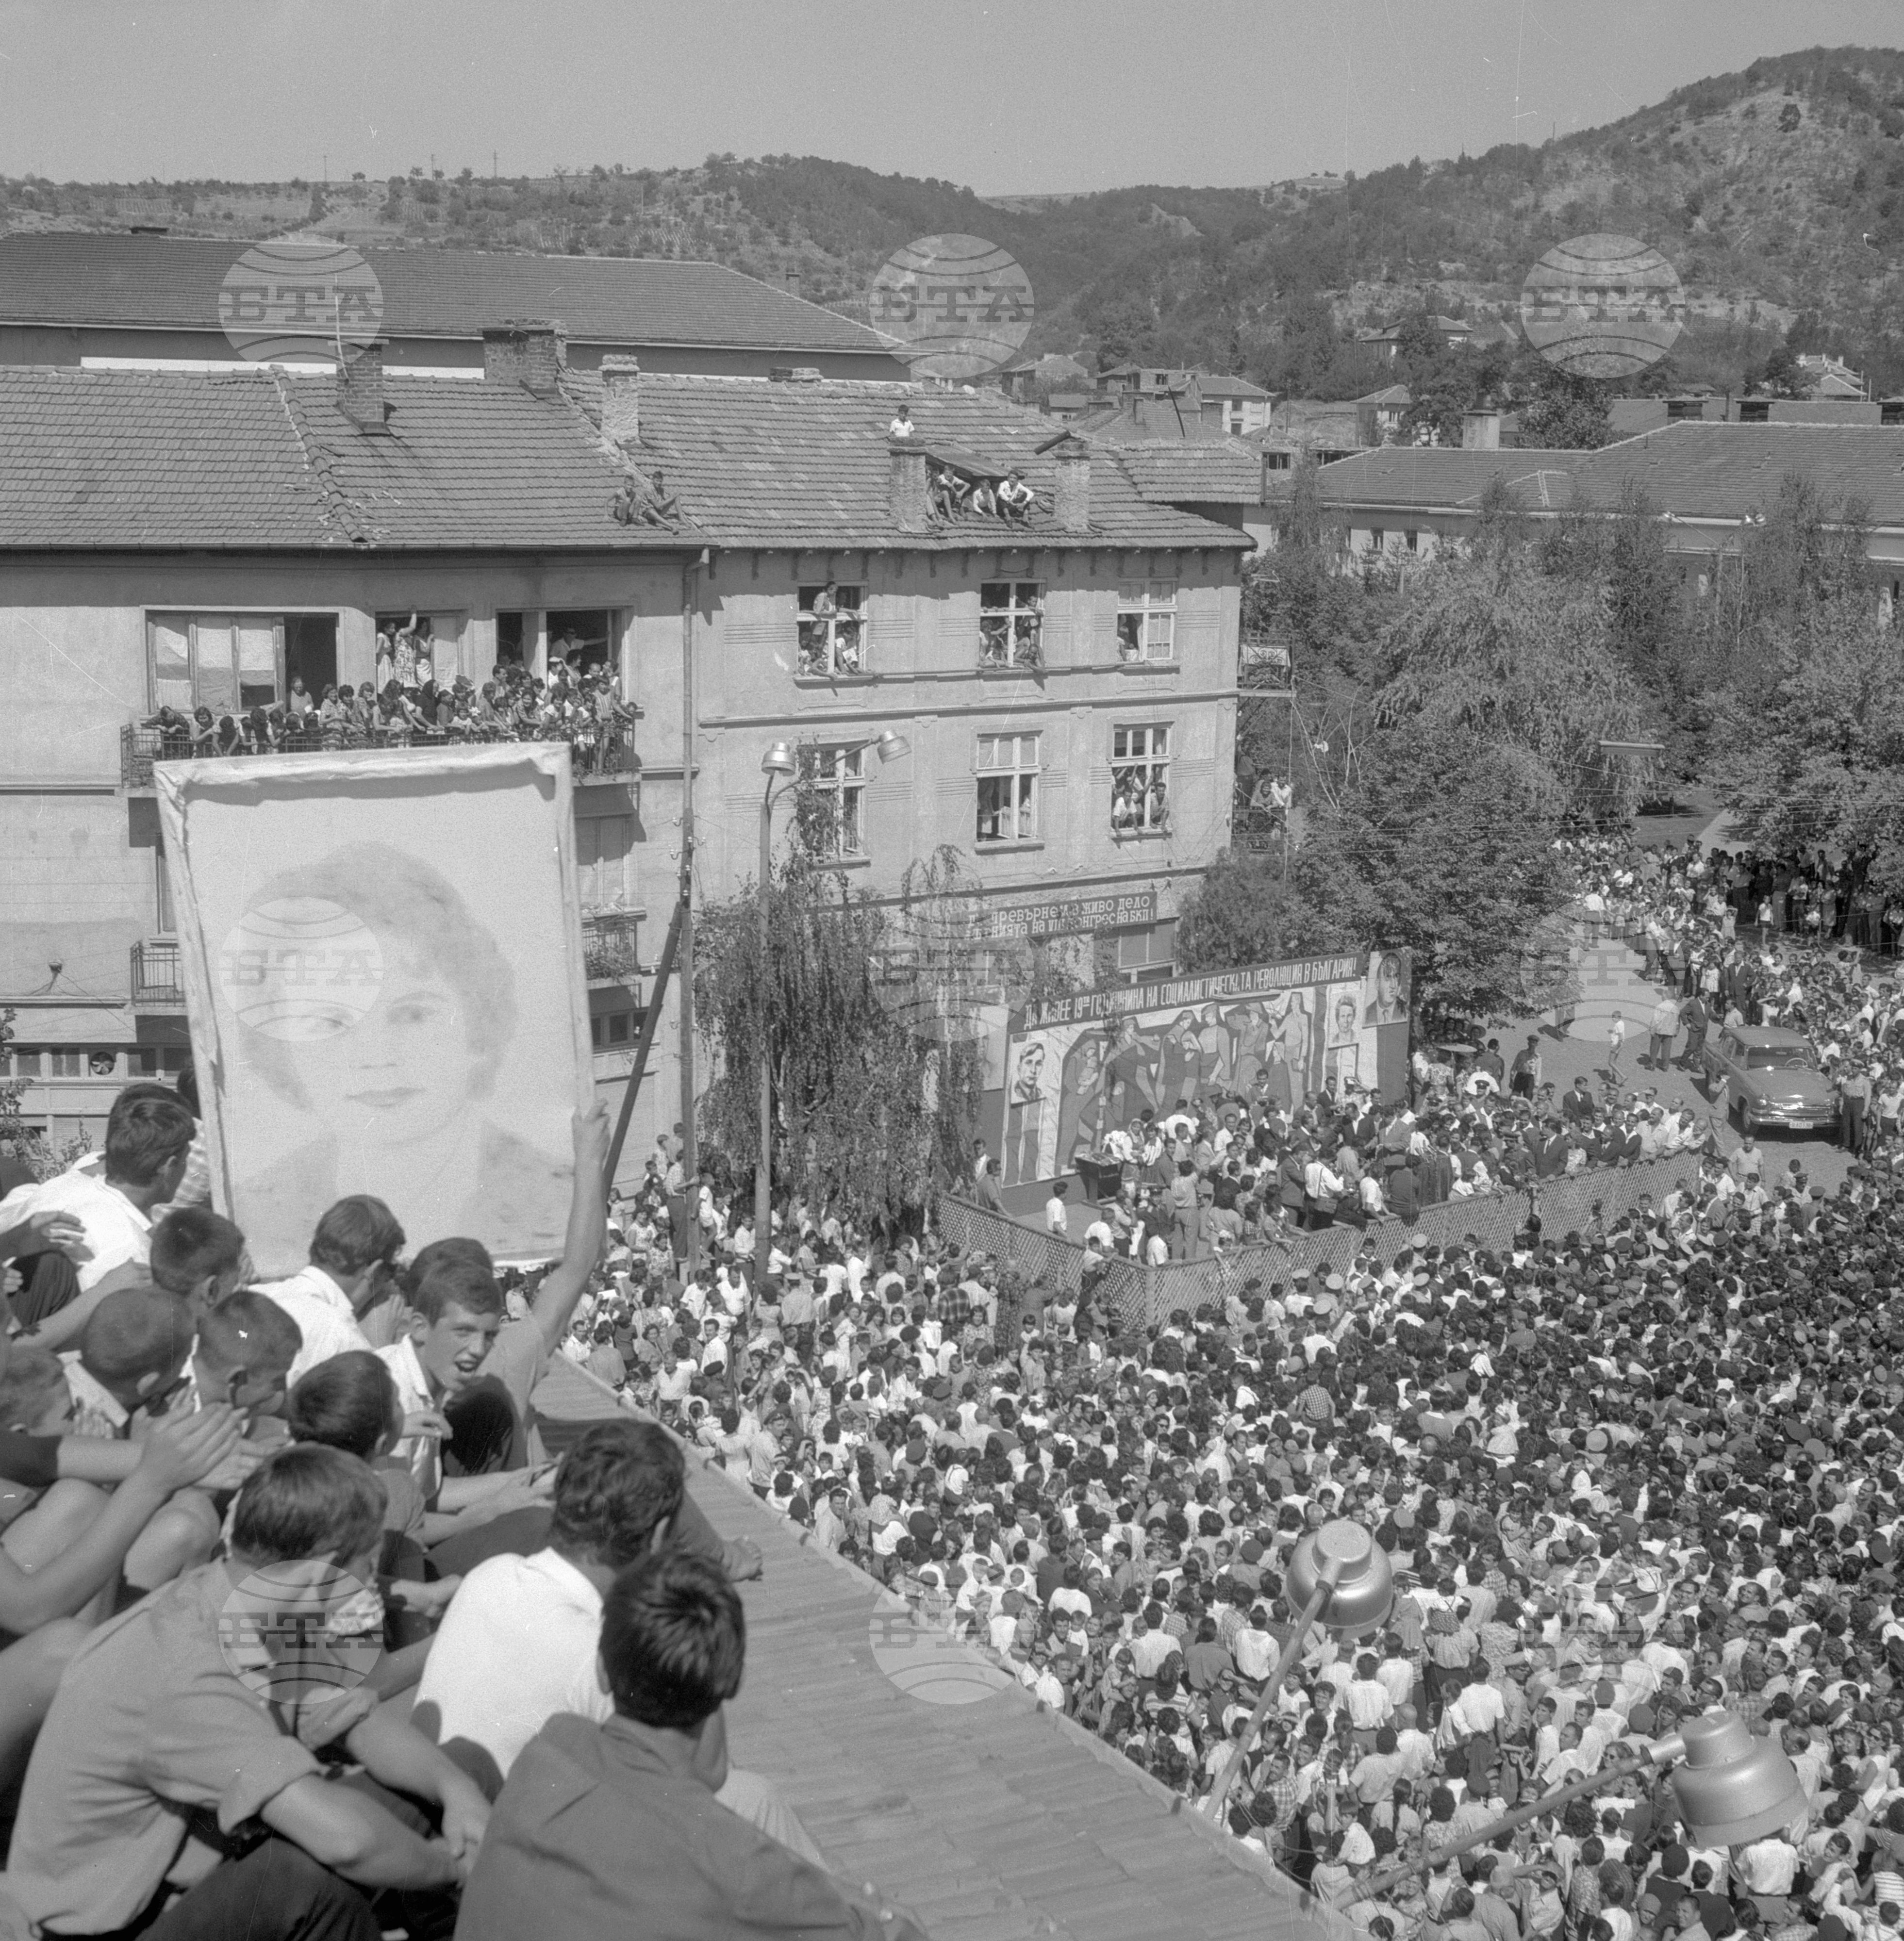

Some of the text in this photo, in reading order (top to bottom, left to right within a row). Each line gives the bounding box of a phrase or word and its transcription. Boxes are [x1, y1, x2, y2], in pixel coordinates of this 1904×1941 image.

[1081, 900, 1114, 914] живо
[1118, 896, 1150, 912] дело
[1032, 920, 1045, 934] на
[1117, 910, 1128, 924] на
[1147, 986, 1158, 1008] НА
[1253, 963, 1303, 990] РЕВОЛЮЦИЯ
[1304, 962, 1310, 984] В
[1311, 957, 1357, 982] БЪЛГАРИЯ!
